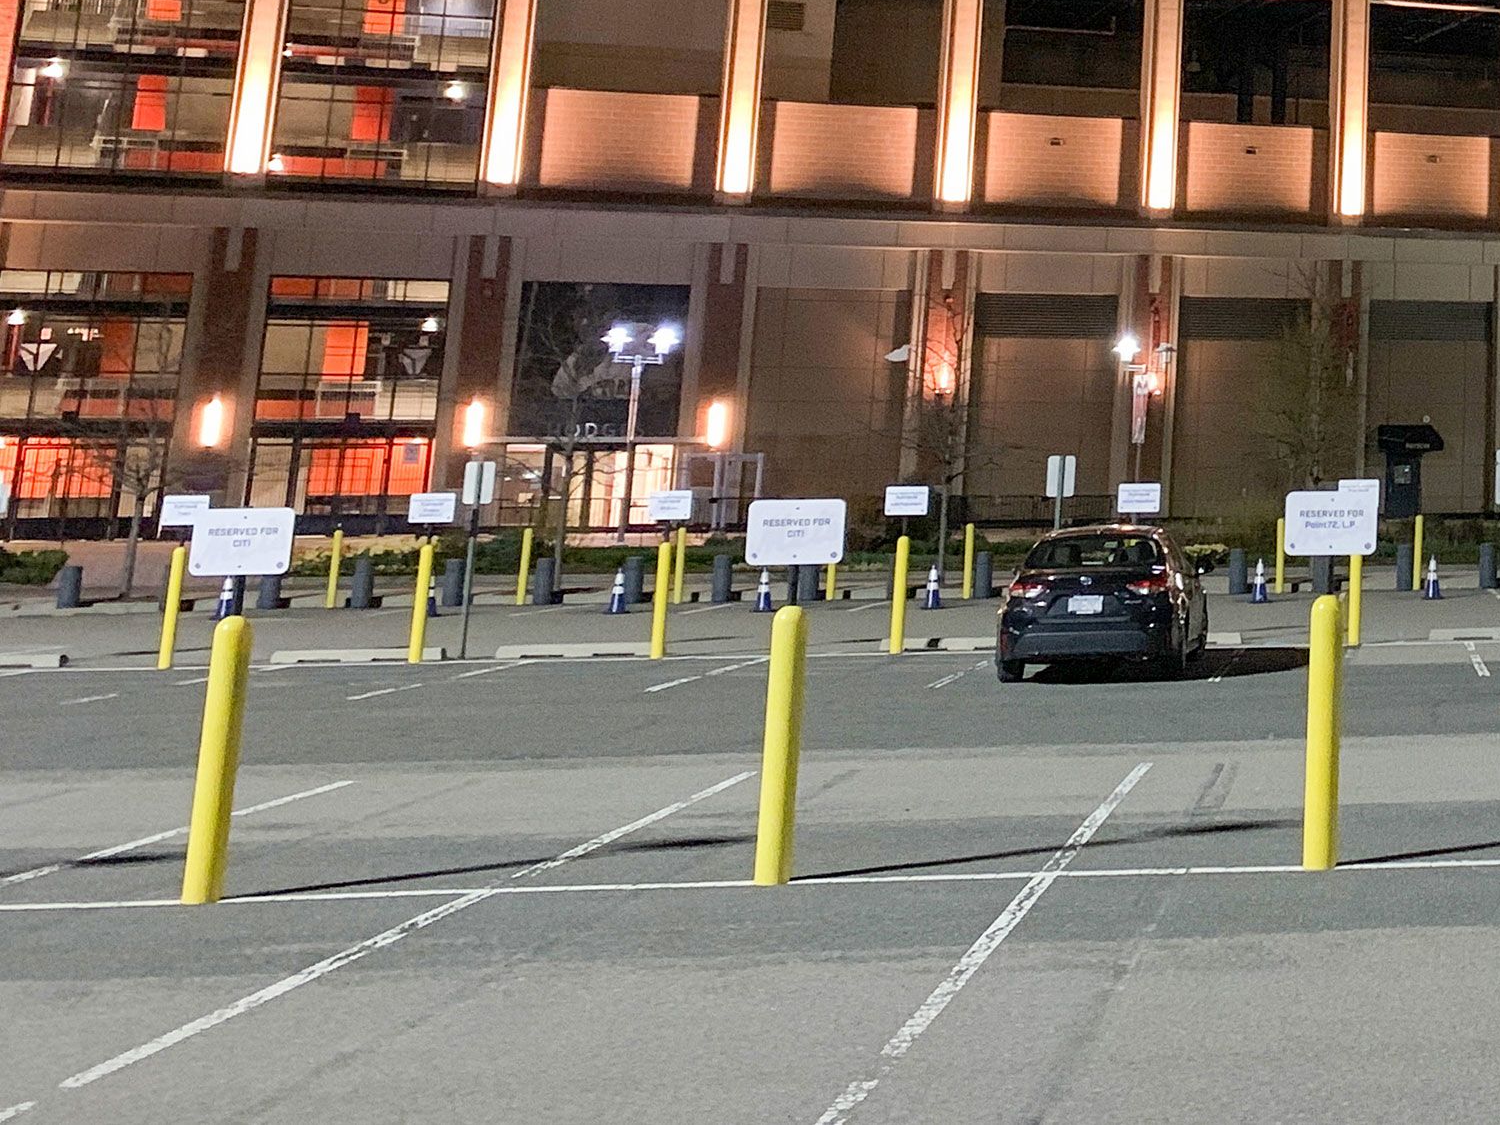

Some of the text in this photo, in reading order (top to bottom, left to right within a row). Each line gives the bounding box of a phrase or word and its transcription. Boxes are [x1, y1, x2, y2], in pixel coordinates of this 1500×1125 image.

[1300, 509, 1364, 518] RESERVED FOR
[763, 518, 831, 527] RESERVED FOR
[208, 527, 279, 536] RESERVED FOR
[787, 530, 805, 538] CITI
[232, 539, 251, 548] CITI
